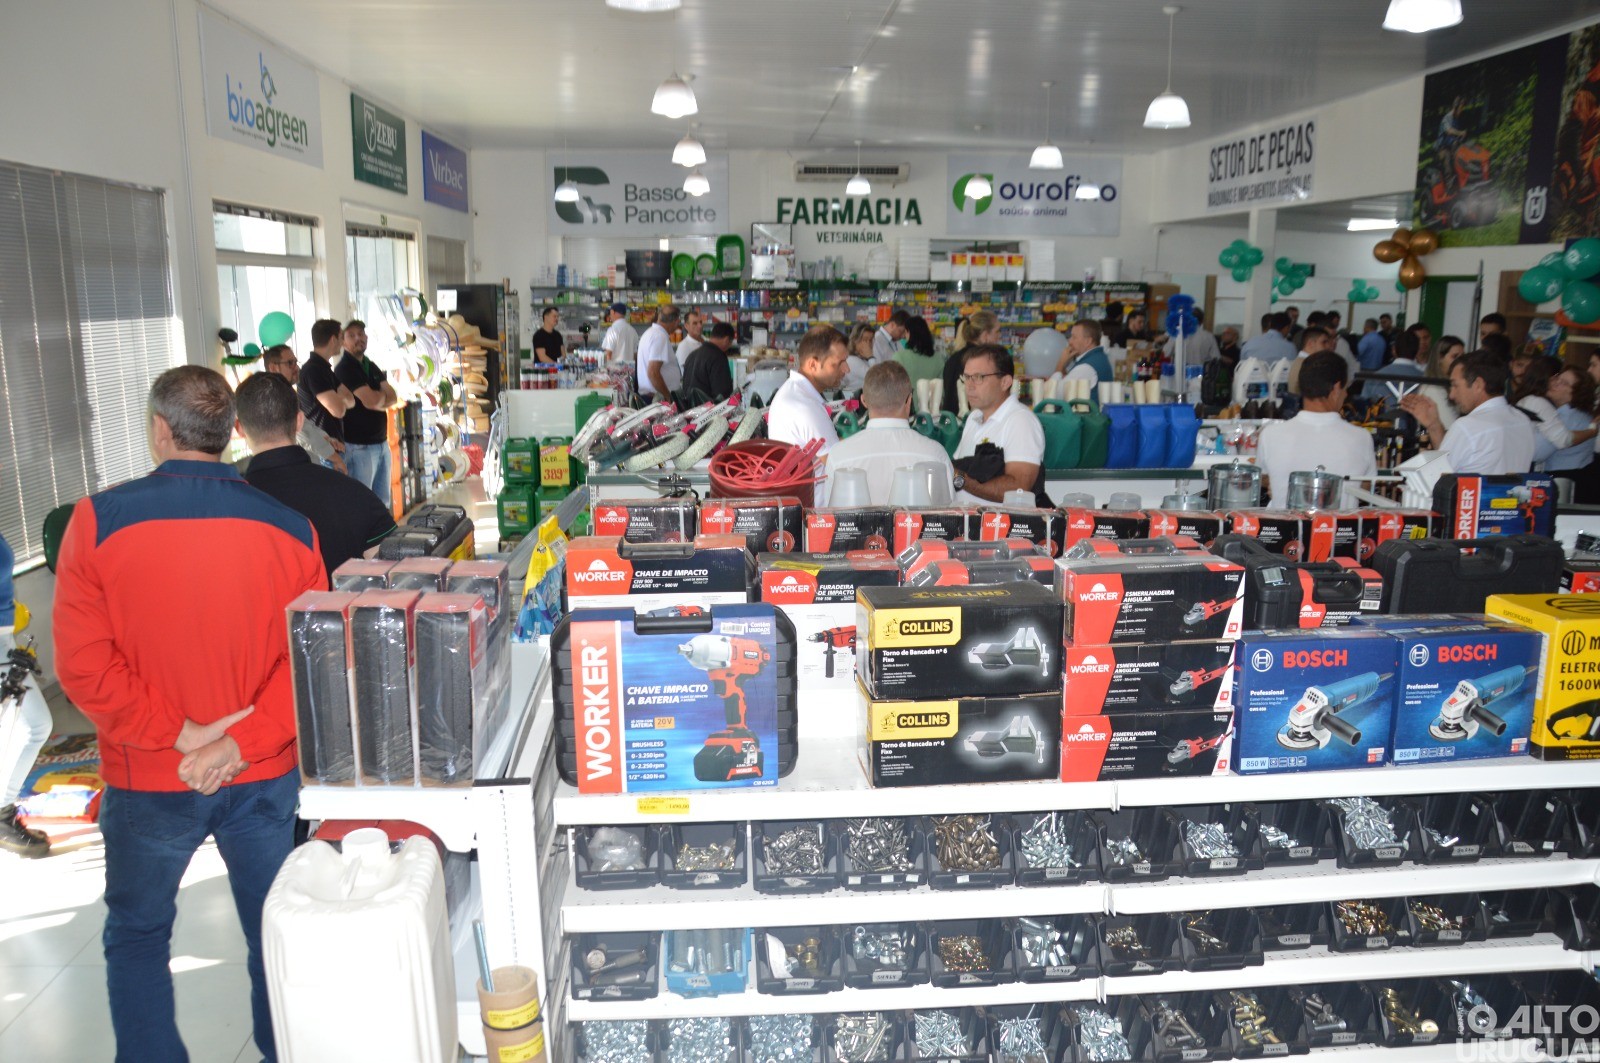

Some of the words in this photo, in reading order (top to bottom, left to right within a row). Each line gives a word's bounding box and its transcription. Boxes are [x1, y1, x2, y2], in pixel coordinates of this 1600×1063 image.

[226, 73, 308, 147] bioagreen
[376, 120, 397, 151] ZEBU
[1209, 141, 1245, 182] SETOR
[1248, 134, 1266, 174] DE
[1268, 121, 1314, 175] PEÇAS
[429, 148, 463, 192] Virbac
[624, 183, 687, 202] Basso
[624, 204, 717, 224] Pancotte
[999, 206, 1031, 217] saúde
[1033, 206, 1068, 217] animal
[887, 281, 938, 289] Medicamentos
[1023, 282, 1073, 290] Medicamentos
[1091, 282, 1140, 291] Medicamentos
[1458, 489, 1475, 539] ORKER
[573, 570, 626, 583] WORKER
[674, 569, 709, 577] IMPACTO
[770, 585, 810, 594] WORKER
[1079, 591, 1118, 602] WORKER
[901, 620, 951, 634] COLLINS
[910, 648, 935, 656] Bancada
[1438, 644, 1498, 663] BOSCH
[1283, 649, 1348, 669] BOSCH
[1070, 664, 1110, 674] WORKER
[626, 686, 661, 695] CHAVE
[663, 684, 709, 693] IMPACTO
[1406, 682, 1439, 690] Professional
[627, 697, 636, 705] A
[637, 695, 680, 705] BATERIA
[581, 646, 613, 780] WORKER
[899, 714, 948, 727] COLLINS
[1067, 733, 1106, 742] WORKER
[1246, 758, 1259, 767] 850
[1259, 758, 1267, 767] W
